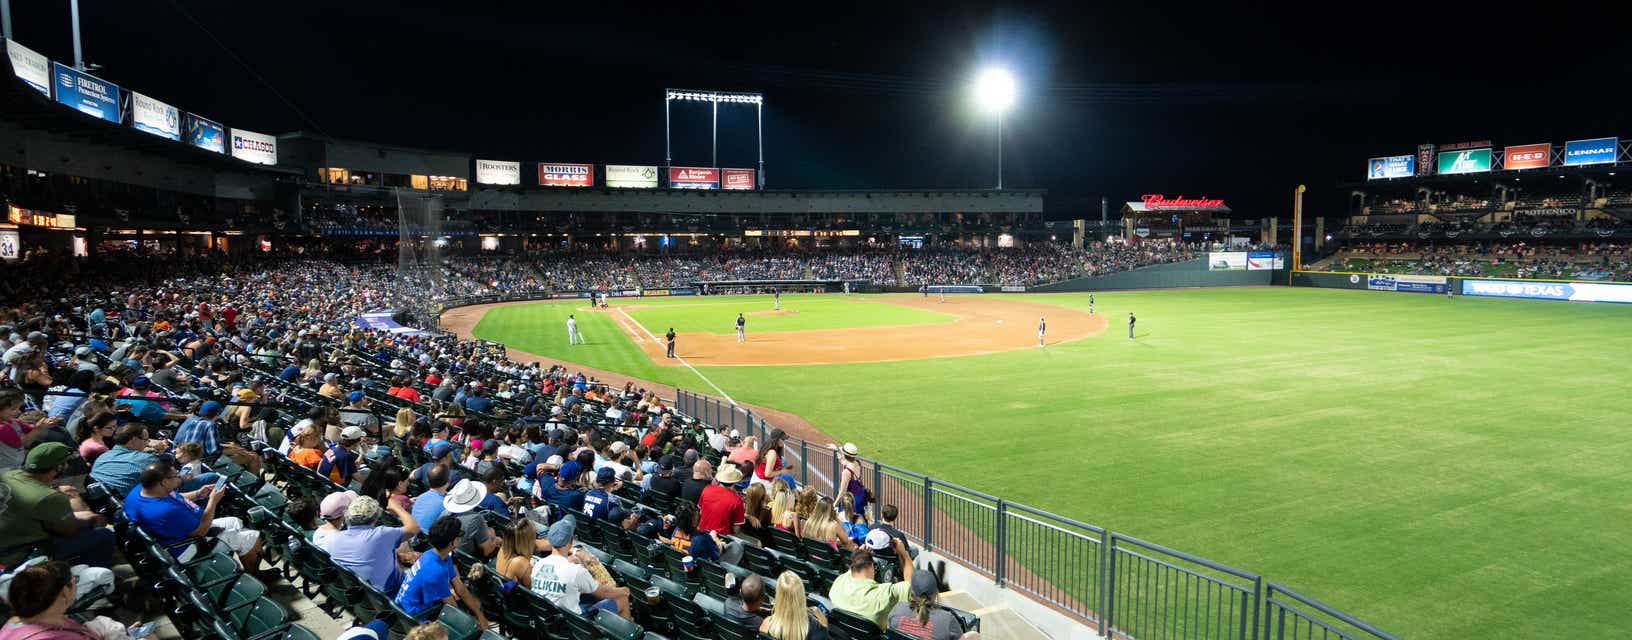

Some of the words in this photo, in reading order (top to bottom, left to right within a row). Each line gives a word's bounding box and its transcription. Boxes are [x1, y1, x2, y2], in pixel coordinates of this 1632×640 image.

[77, 76, 107, 95] FIRETROL
[78, 86, 101, 99] Protection
[101, 94, 116, 105] Systems
[243, 138, 274, 154] CHASCO
[1568, 147, 1614, 156] LENNAR
[545, 166, 588, 174] MORRIS
[1141, 193, 1224, 209] Budweiser
[2, 242, 14, 257] 34
[1523, 283, 1562, 297] TEXAS
[533, 577, 567, 594] ELIKIN
